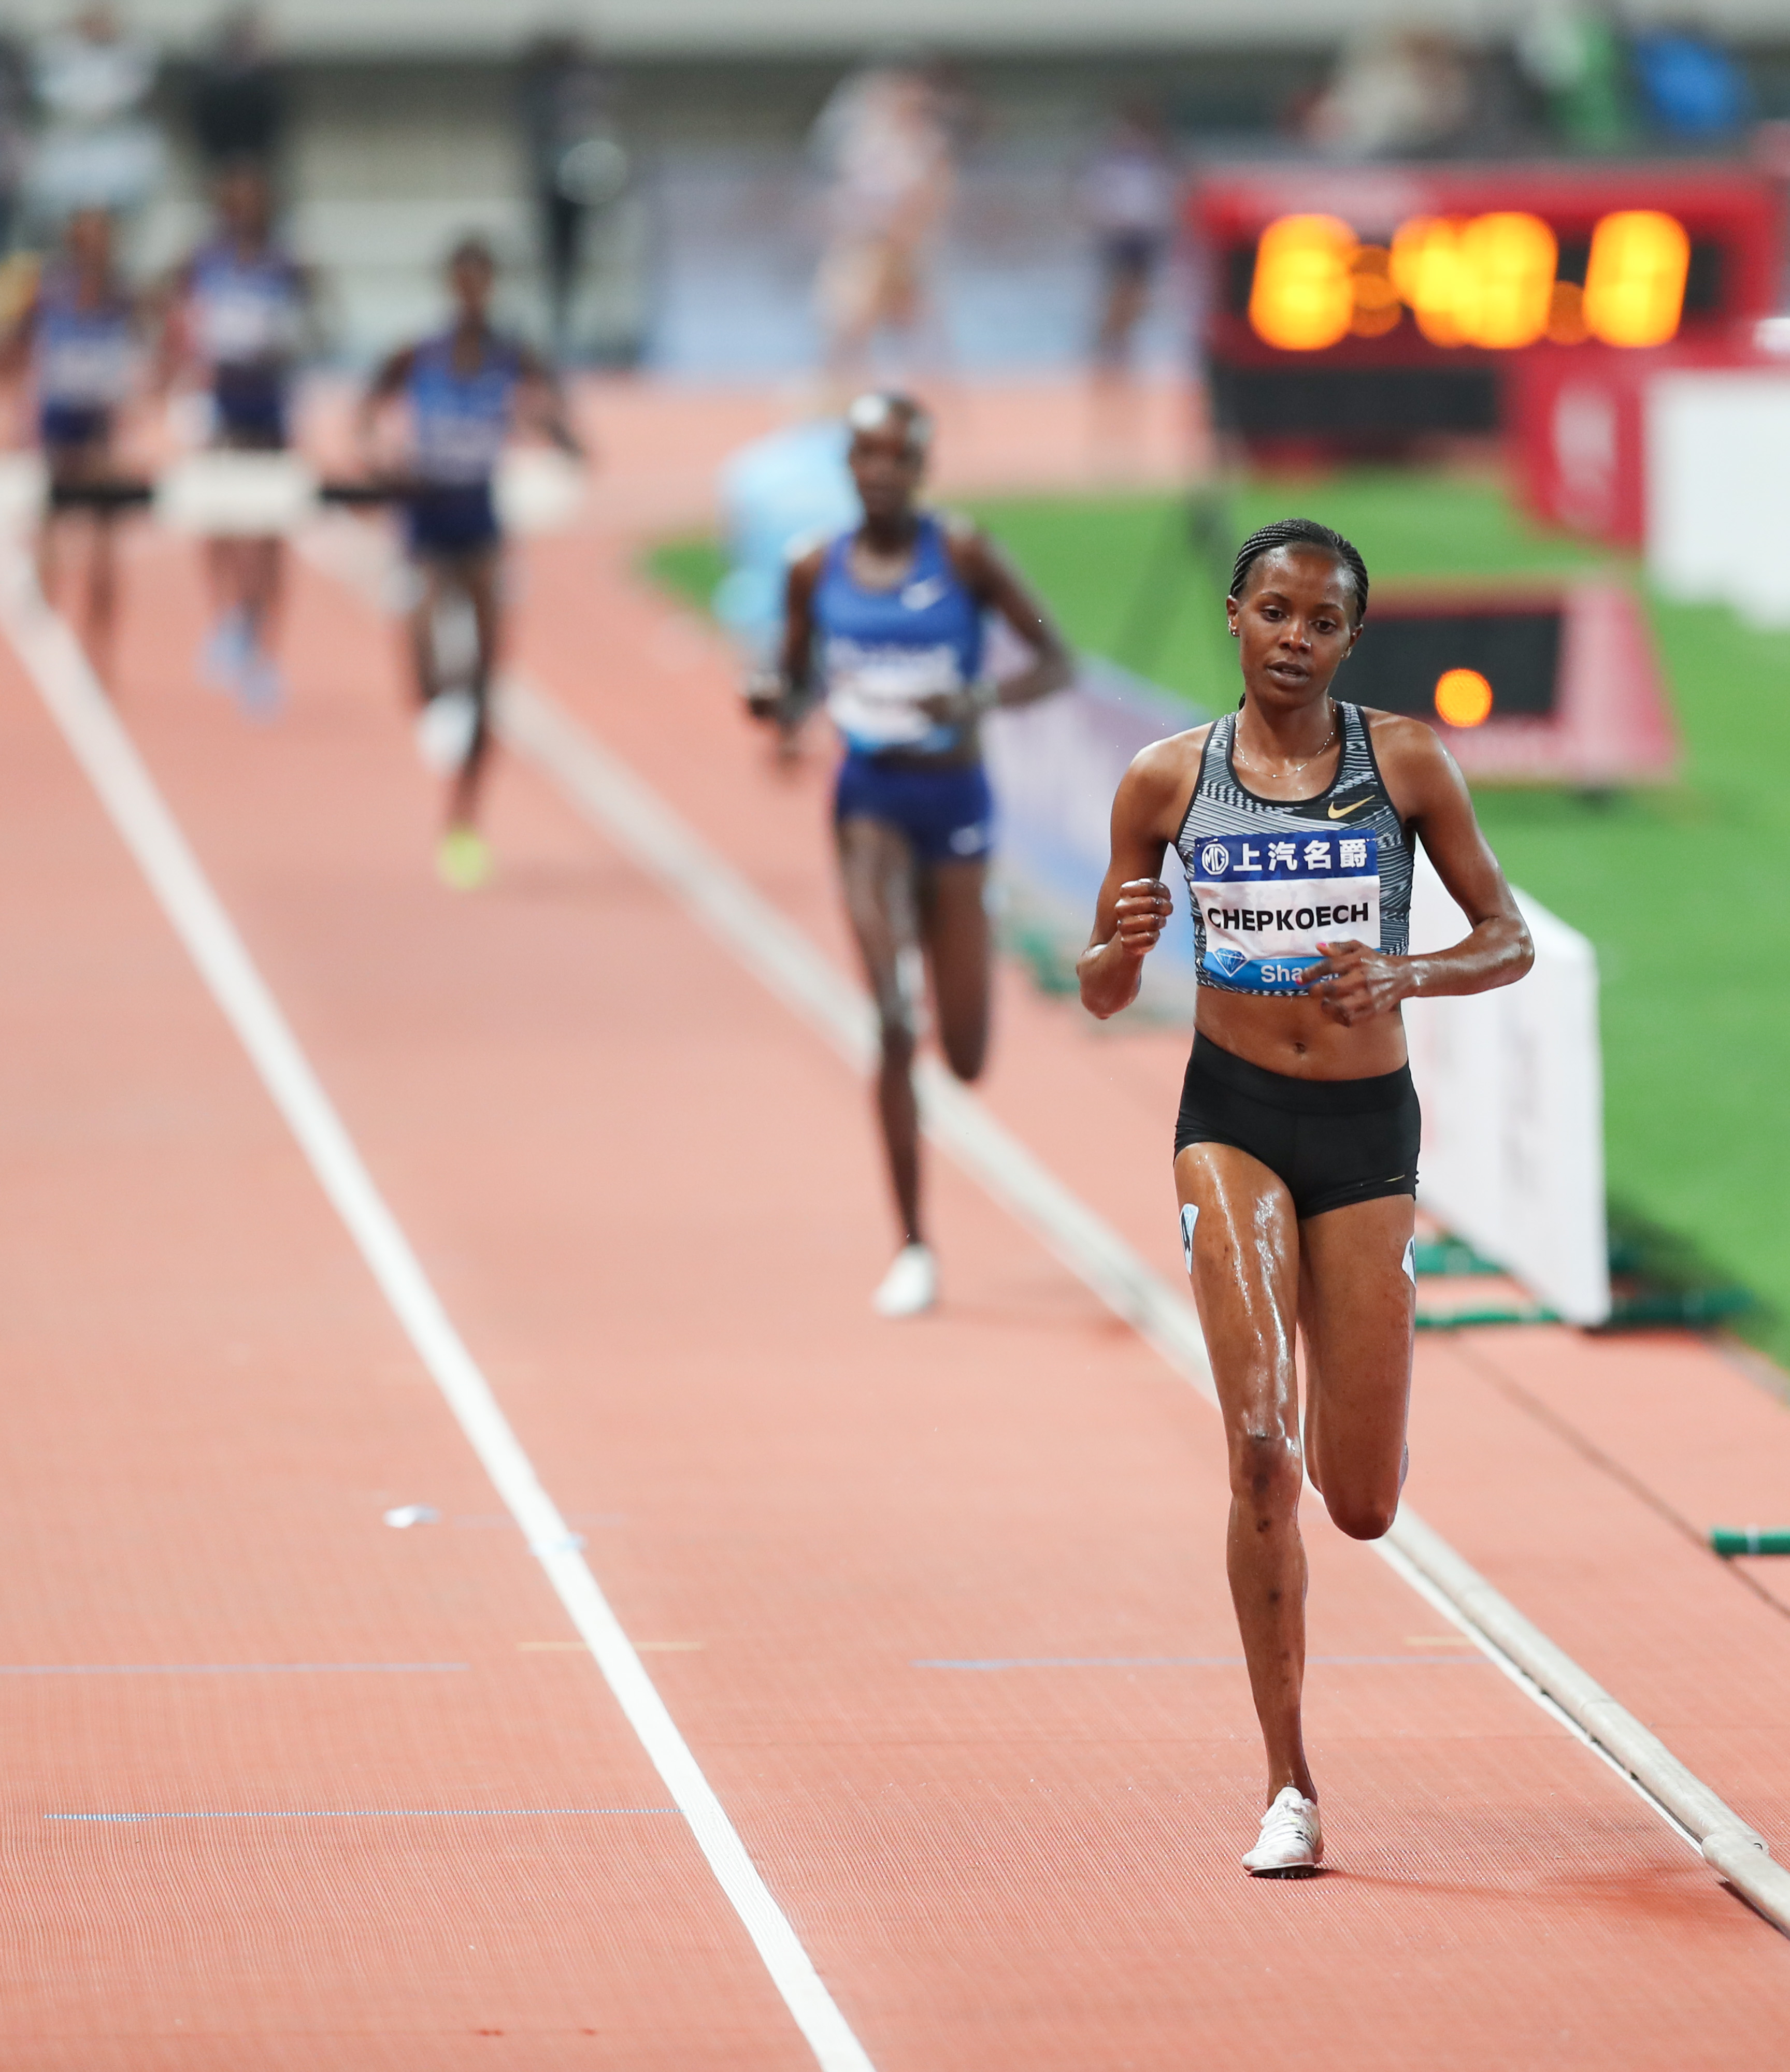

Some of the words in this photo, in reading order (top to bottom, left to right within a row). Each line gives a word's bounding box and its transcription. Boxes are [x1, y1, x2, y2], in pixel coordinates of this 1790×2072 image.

[1204, 846, 1227, 873] MG
[1233, 839, 1367, 872] 上汽名爵
[1208, 902, 1368, 931] CHEPKOECH
